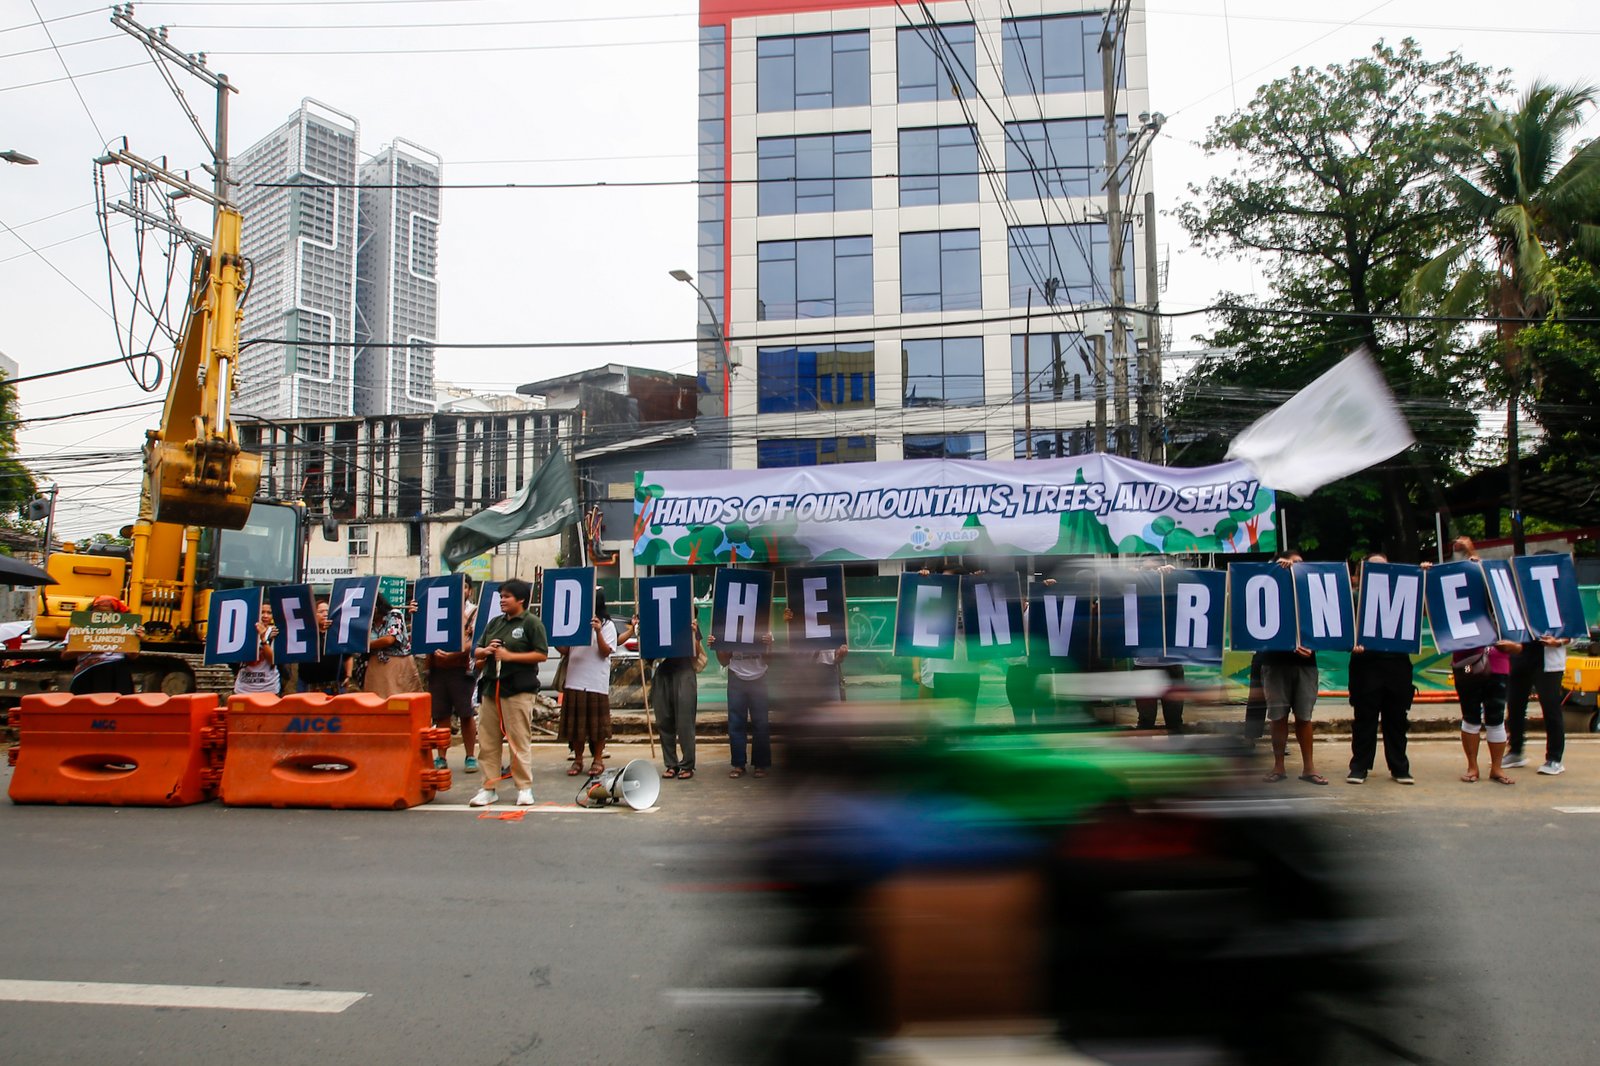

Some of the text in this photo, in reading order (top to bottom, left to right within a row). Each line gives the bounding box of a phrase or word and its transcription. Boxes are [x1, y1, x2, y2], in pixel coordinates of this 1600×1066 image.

[650, 480, 1260, 526] HANDS OFF OUR MOUNTAINS, TREES, AND SEAS!
[936, 530, 978, 542] YACAP
[90, 611, 121, 623] END
[287, 717, 342, 733] AICC
